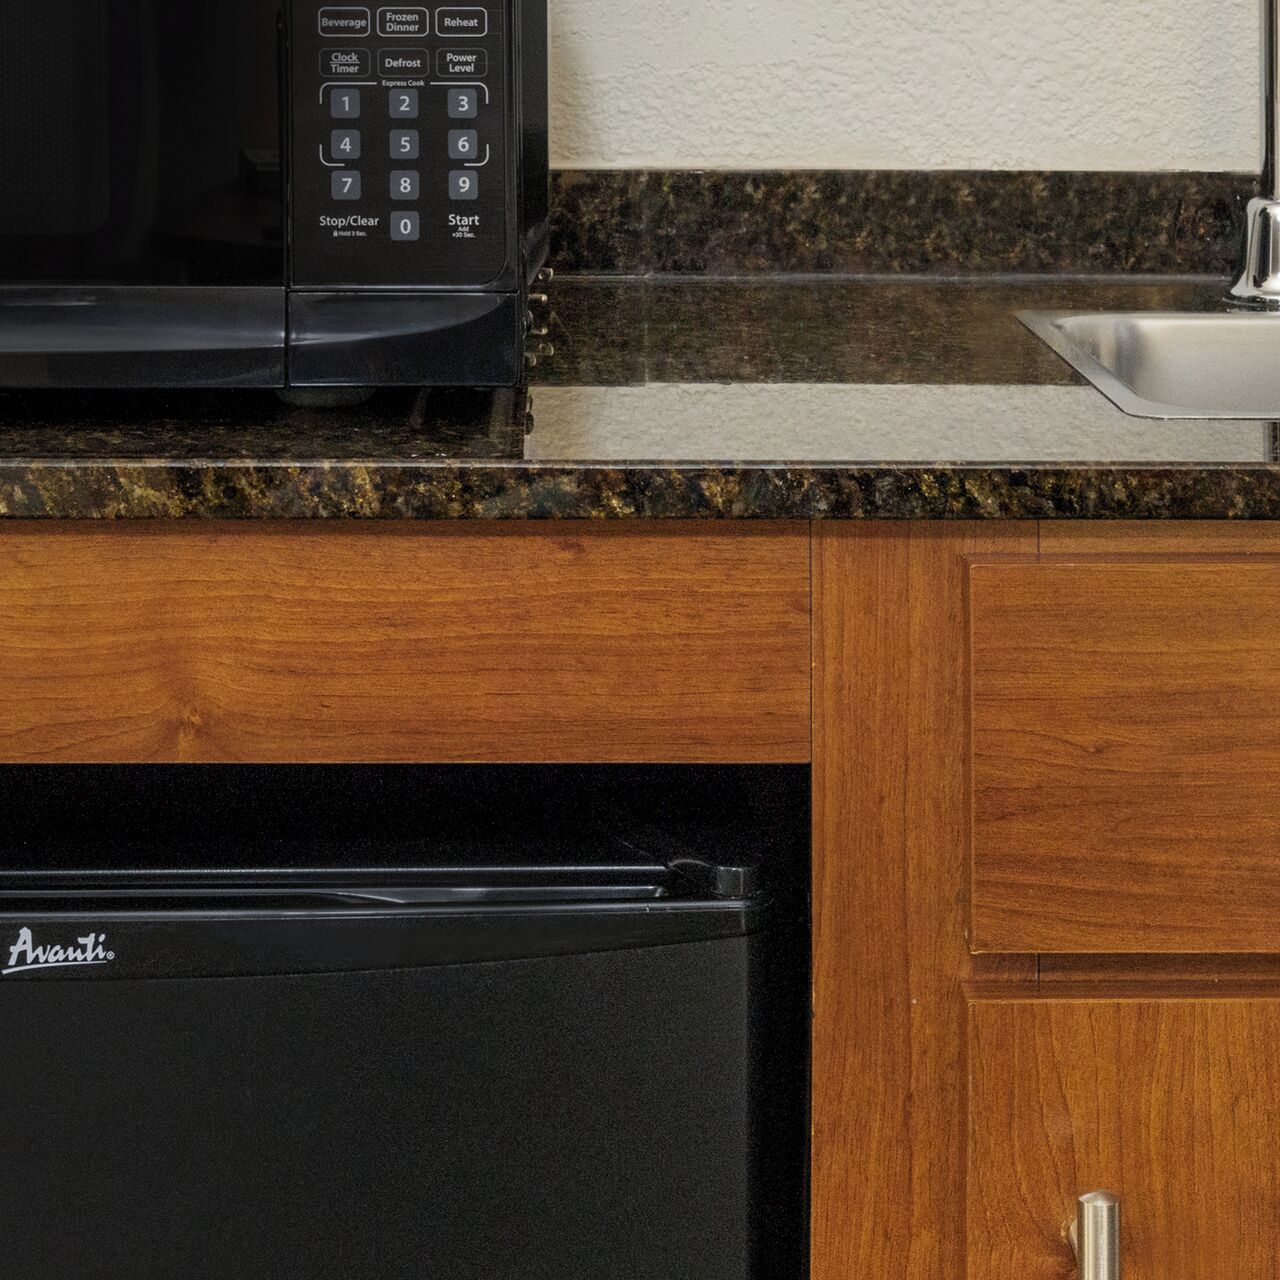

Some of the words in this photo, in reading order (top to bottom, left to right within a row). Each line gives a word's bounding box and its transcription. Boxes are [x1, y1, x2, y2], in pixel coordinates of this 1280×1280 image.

[321, 17, 368, 30] Beverage
[387, 12, 418, 21] Frozen
[444, 17, 479, 27] Reheat
[387, 23, 419, 31] Dinner
[332, 53, 358, 61] Clock
[384, 57, 421, 68] Defrost
[447, 53, 476, 62] Power
[331, 64, 359, 73] Timer
[450, 63, 474, 72] Level
[382, 79, 407, 87] Express
[341, 96, 349, 112] 1
[399, 95, 410, 111] 2
[458, 95, 469, 112] 3
[339, 137, 352, 153] 4
[400, 136, 411, 153] 5
[457, 136, 470, 152] 6
[341, 177, 353, 193] 7
[399, 177, 412, 193] 8
[458, 176, 470, 193] 9
[319, 215, 380, 229] Stop/Clear
[400, 218, 412, 235] 0
[448, 213, 480, 226] Start
[8, 926, 107, 966] Avanti
